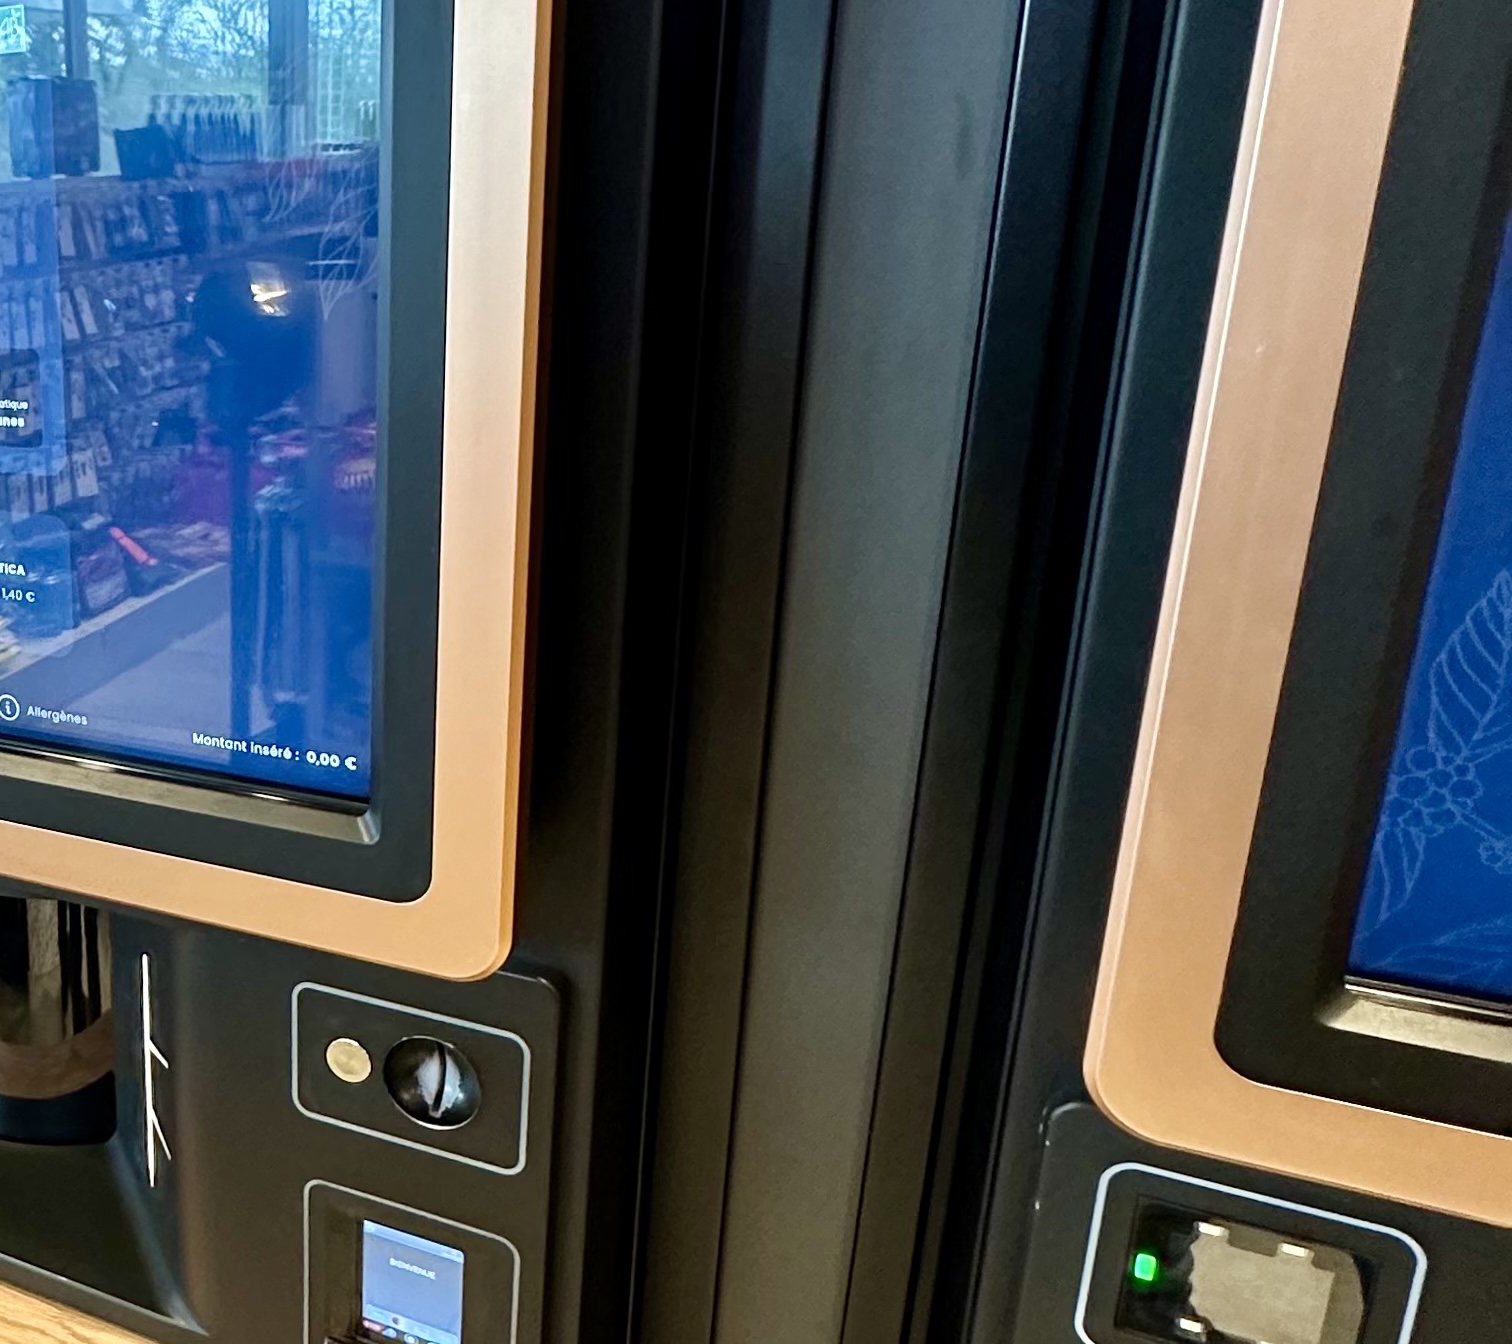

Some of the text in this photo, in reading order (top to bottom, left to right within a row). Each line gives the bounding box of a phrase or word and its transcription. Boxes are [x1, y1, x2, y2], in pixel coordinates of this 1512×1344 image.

[1, 587, 23, 602] 1,40
[25, 590, 36, 603] €
[26, 705, 88, 727] Allergènes
[192, 731, 248, 753] Montant
[249, 740, 293, 760] inséré
[305, 750, 340, 768] 0,00
[343, 756, 358, 771] €
